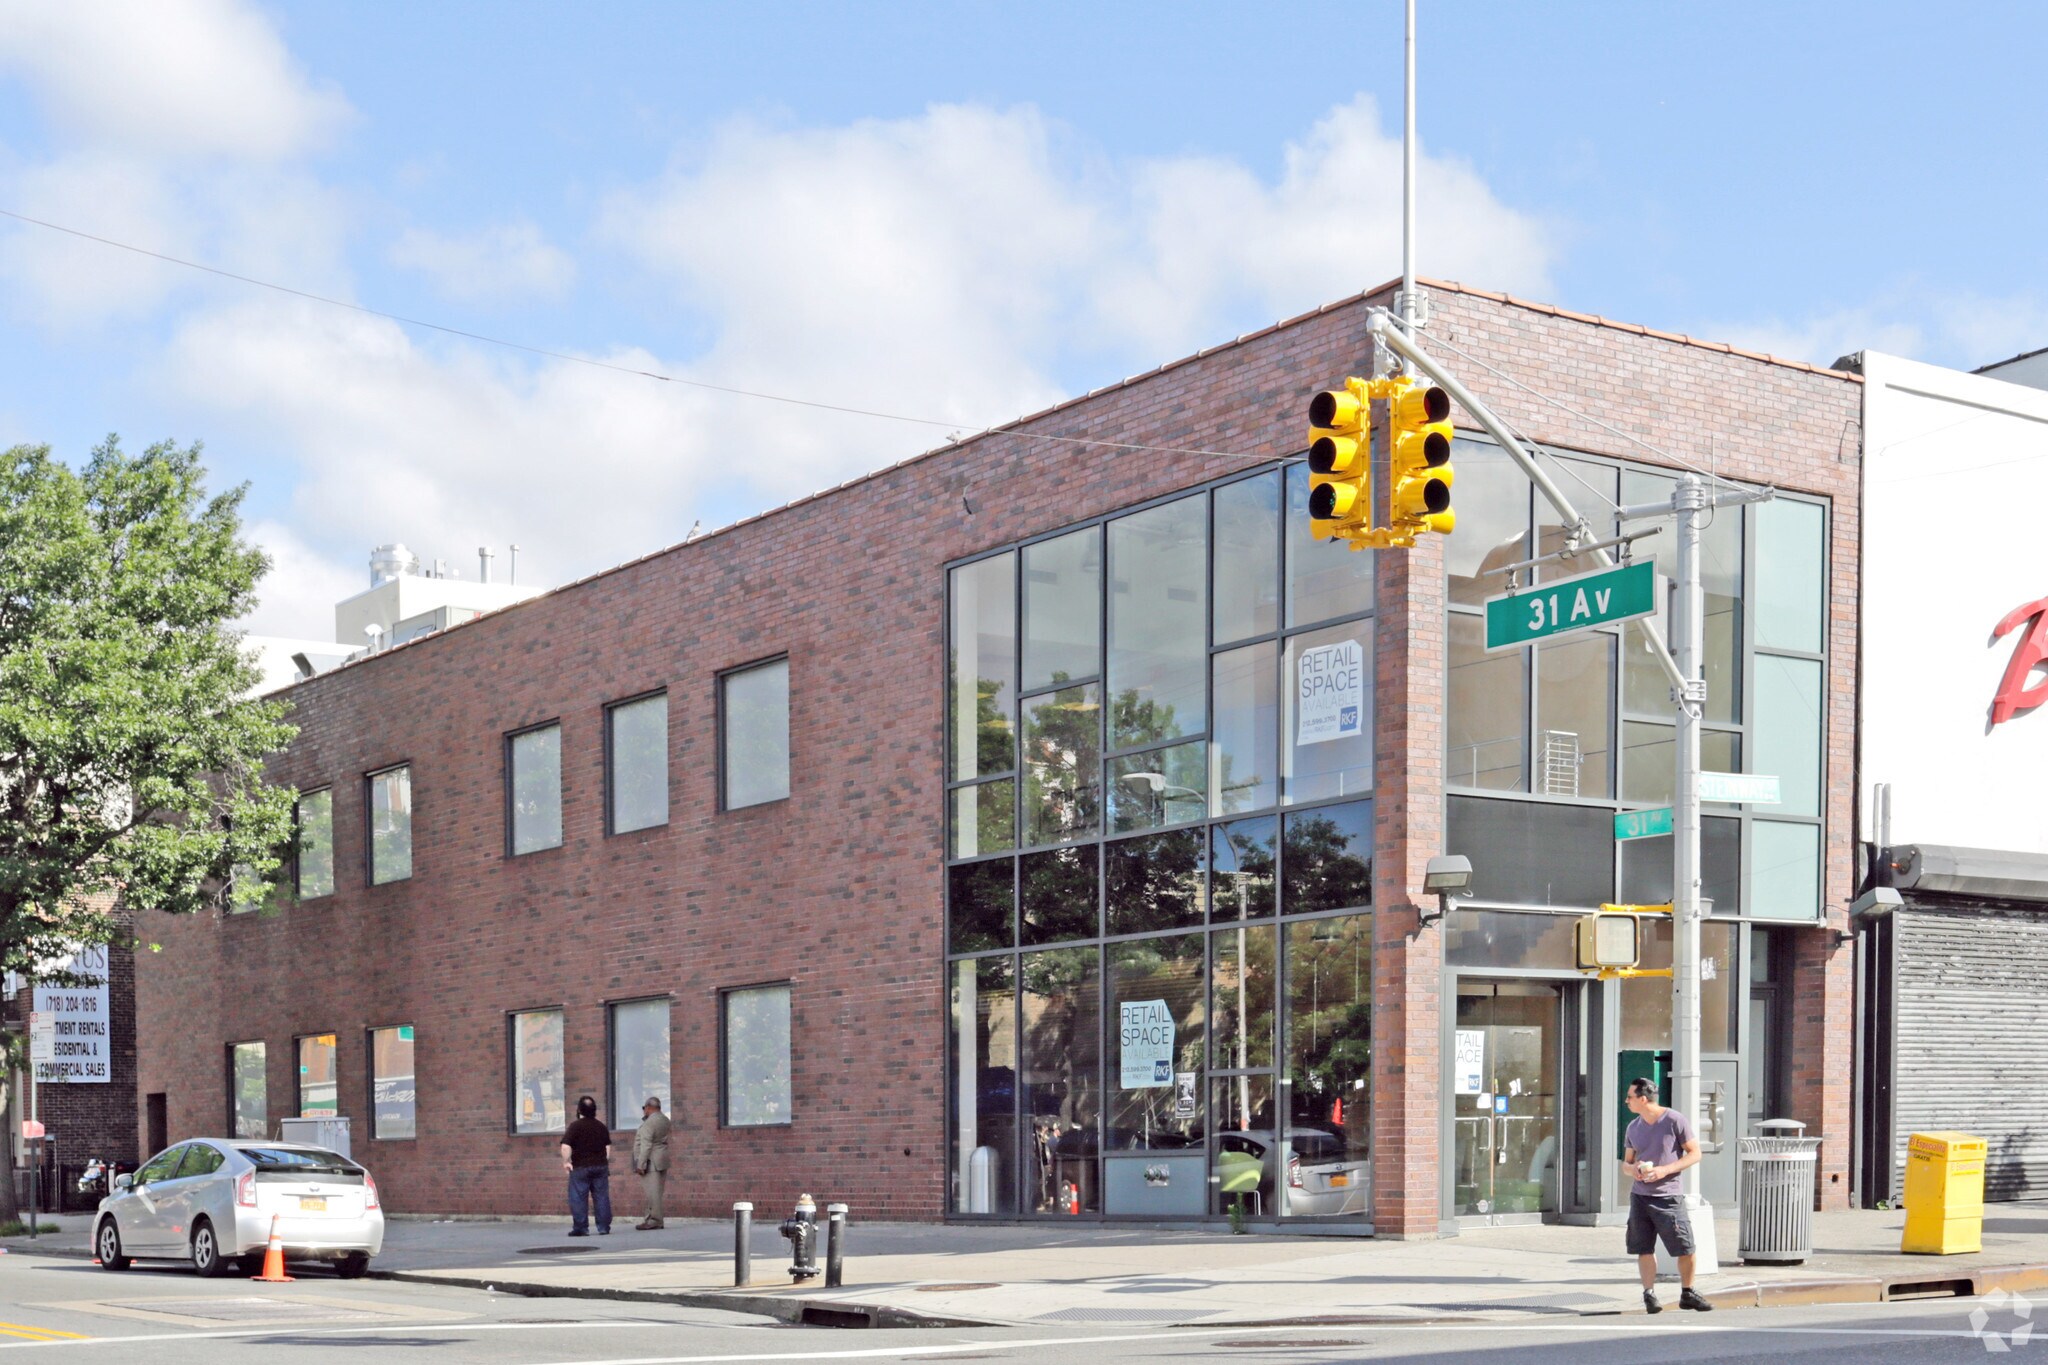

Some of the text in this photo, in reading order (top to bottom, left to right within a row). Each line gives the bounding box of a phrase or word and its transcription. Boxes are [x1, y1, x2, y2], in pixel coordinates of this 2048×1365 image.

[1528, 594, 1558, 631] 31
[1301, 646, 1358, 675] RETAIL
[1301, 668, 1358, 698] SPACE
[1302, 691, 1358, 713] AVAILABLE
[1341, 711, 1357, 726] RKF
[1628, 814, 1647, 836] 31
[45, 996, 97, 1012] (718) 204-1616
[1121, 1005, 1171, 1025] RETAIL
[55, 1022, 105, 1036] TMENT RENTALS
[1121, 1026, 1170, 1047] SPACE
[1456, 1033, 1482, 1047] TAIL
[54, 1042, 90, 1056] ESIDENTIAL
[93, 1042, 98, 1056] &
[1122, 1047, 1170, 1060] AVAILABLE
[1456, 1049, 1481, 1063] ACE
[40, 1062, 105, 1076] COMMERCIAL SALES
[1155, 1065, 1170, 1077] RKF
